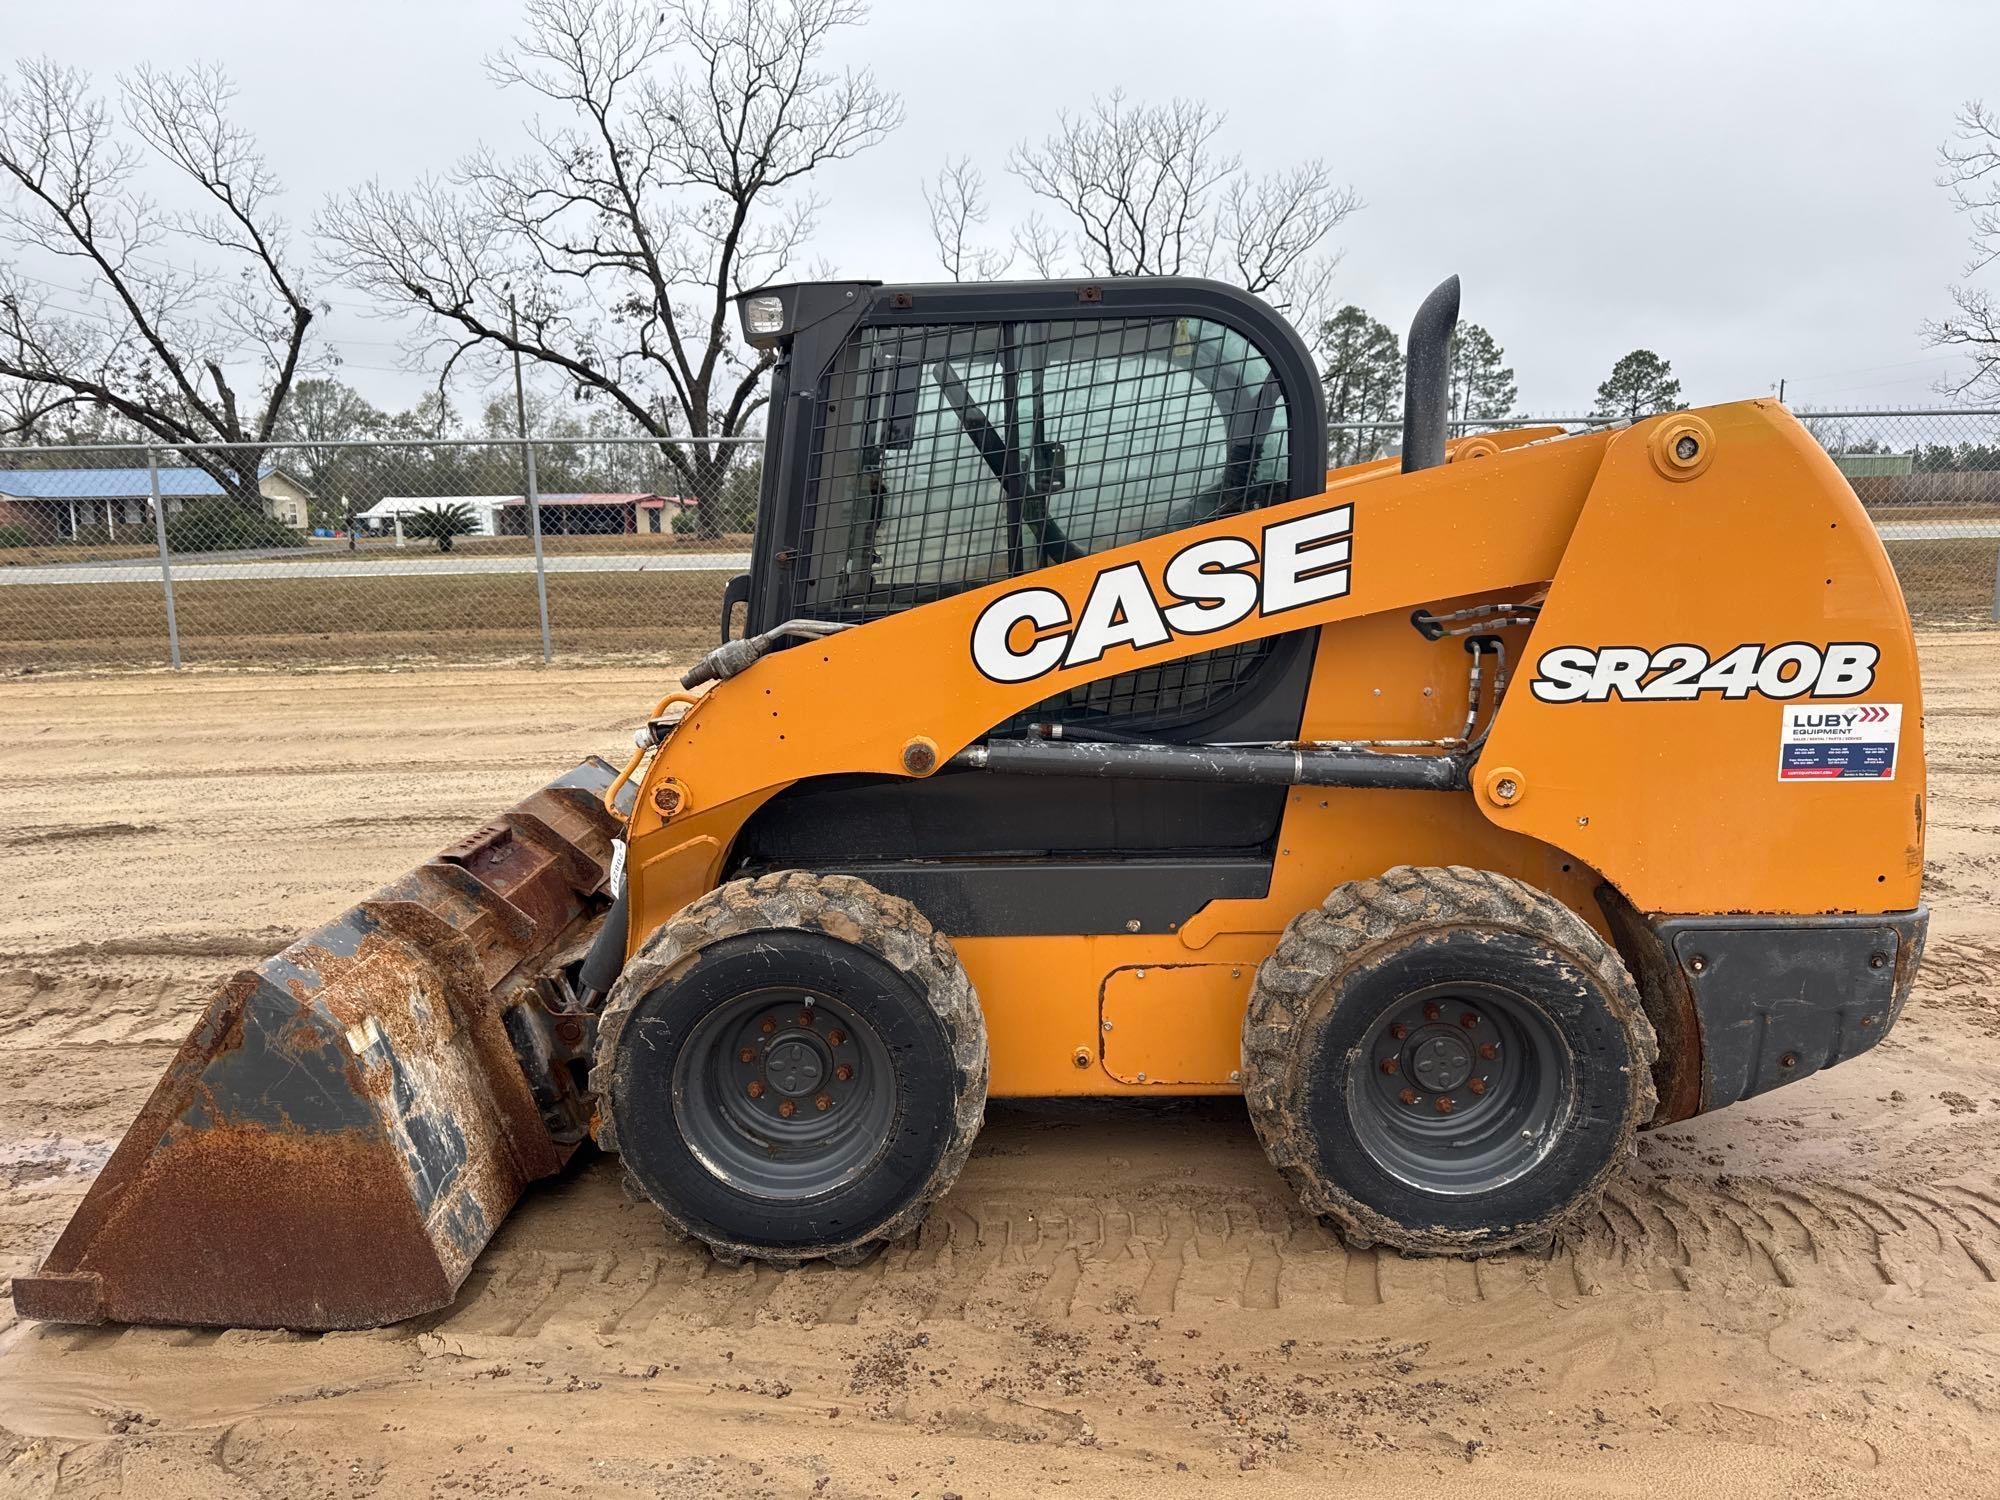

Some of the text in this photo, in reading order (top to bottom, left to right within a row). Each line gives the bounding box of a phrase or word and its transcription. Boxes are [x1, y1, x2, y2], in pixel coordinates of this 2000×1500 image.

[970, 502, 1355, 684] CASE
[1529, 641, 1881, 705] SR240B
[1792, 728, 1853, 736] EQUIPMENT
[1793, 714, 1858, 728] LUBY
